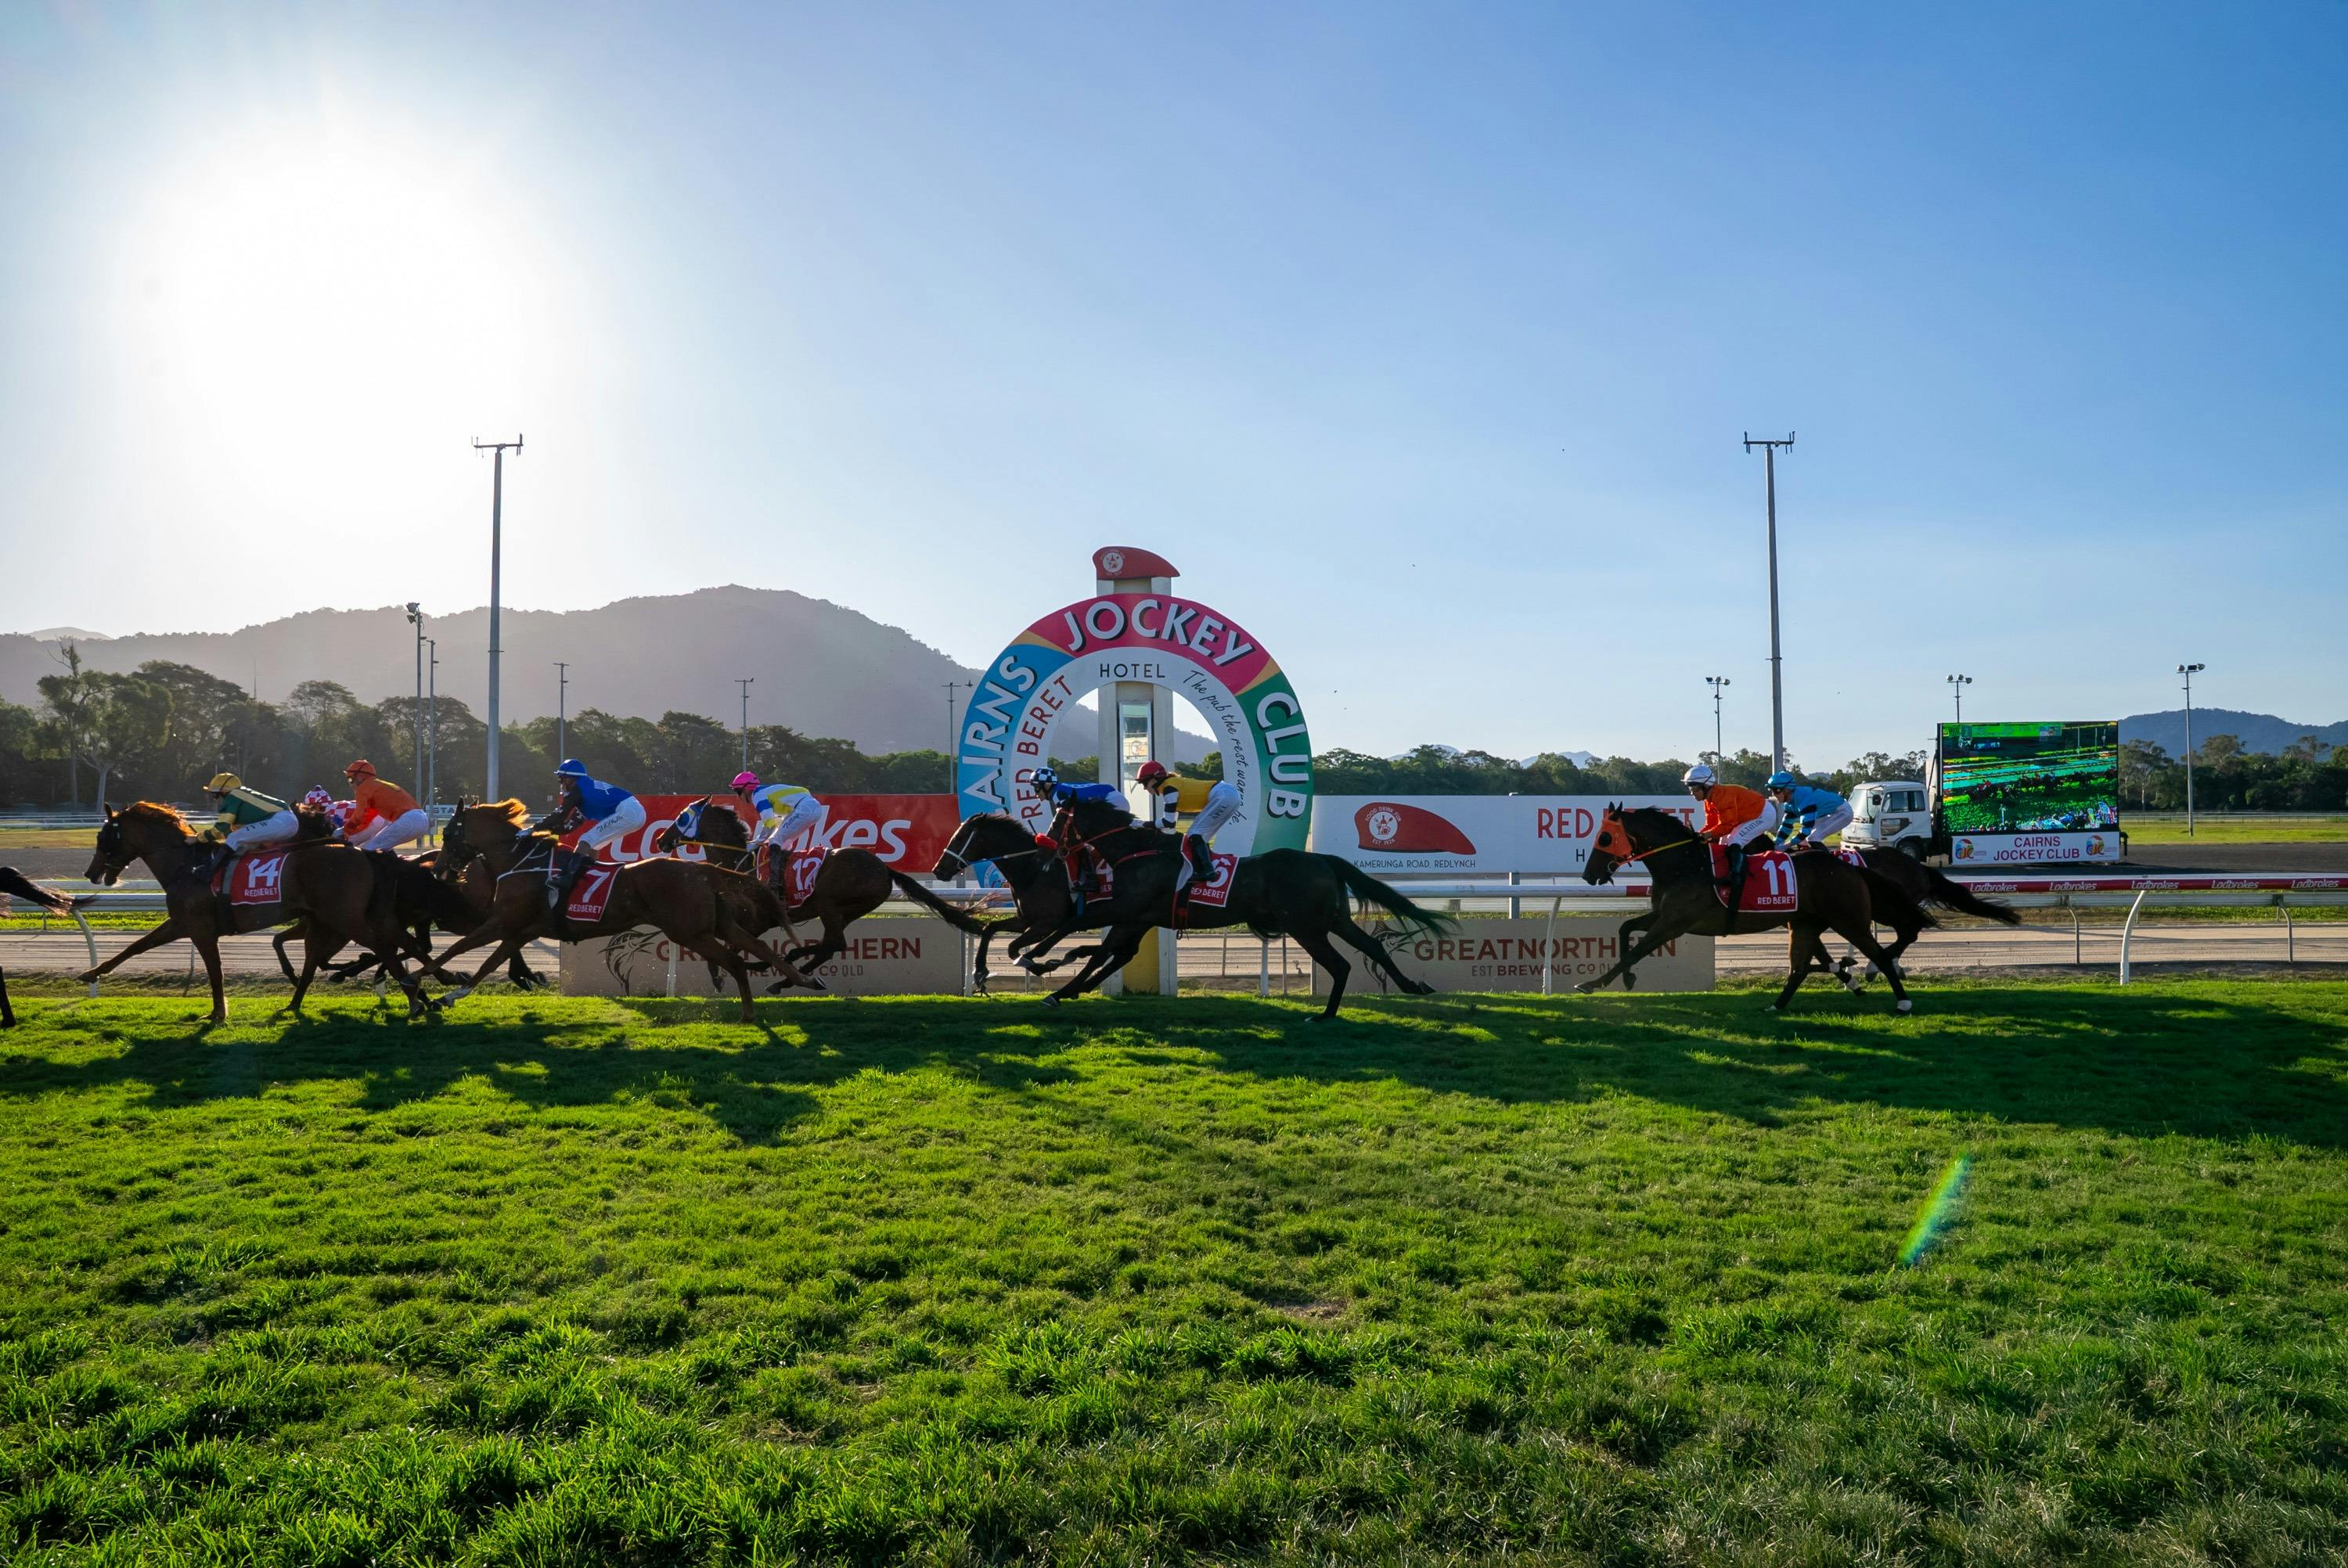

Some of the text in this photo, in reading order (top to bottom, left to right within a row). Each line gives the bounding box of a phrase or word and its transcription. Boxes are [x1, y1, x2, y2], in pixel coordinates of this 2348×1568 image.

[962, 599, 1309, 817] AIRNS JOCKEY CLUB
[1017, 674, 1072, 756] BERET
[1100, 664, 1165, 678] HOTEL
[1183, 670, 1208, 694] The
[1199, 695, 1226, 713] pub
[1221, 714, 1241, 735] the
[1231, 738, 1249, 768] rest
[1365, 808, 1378, 822] FOOD
[1394, 811, 1403, 822] FUN
[1538, 808, 1594, 838] RED
[2014, 836, 2060, 848] CAIRNS
[1993, 849, 2044, 861] JOCKEY
[2046, 848, 2080, 859] CLUB
[1354, 859, 1403, 869] KAMERUNGA
[1434, 859, 1475, 869] REDLYNCH
[248, 857, 282, 888] 14
[792, 857, 822, 890] 12
[1762, 860, 1795, 895] 11
[586, 869, 610, 903] 7
[1969, 883, 2017, 893] Ladbrokes
[2049, 881, 2097, 891] Ladbrokes
[2131, 880, 2180, 890] Ladbrokes
[2211, 879, 2259, 889] Ladbrokes
[2291, 879, 2339, 889] Ladbrokes
[1202, 888, 1226, 899] BERET
[1757, 896, 1795, 905] RED BERET
[1414, 938, 1514, 961] GREAT
[1471, 965, 1493, 976] EST
[1497, 963, 1572, 976] BREWNG
